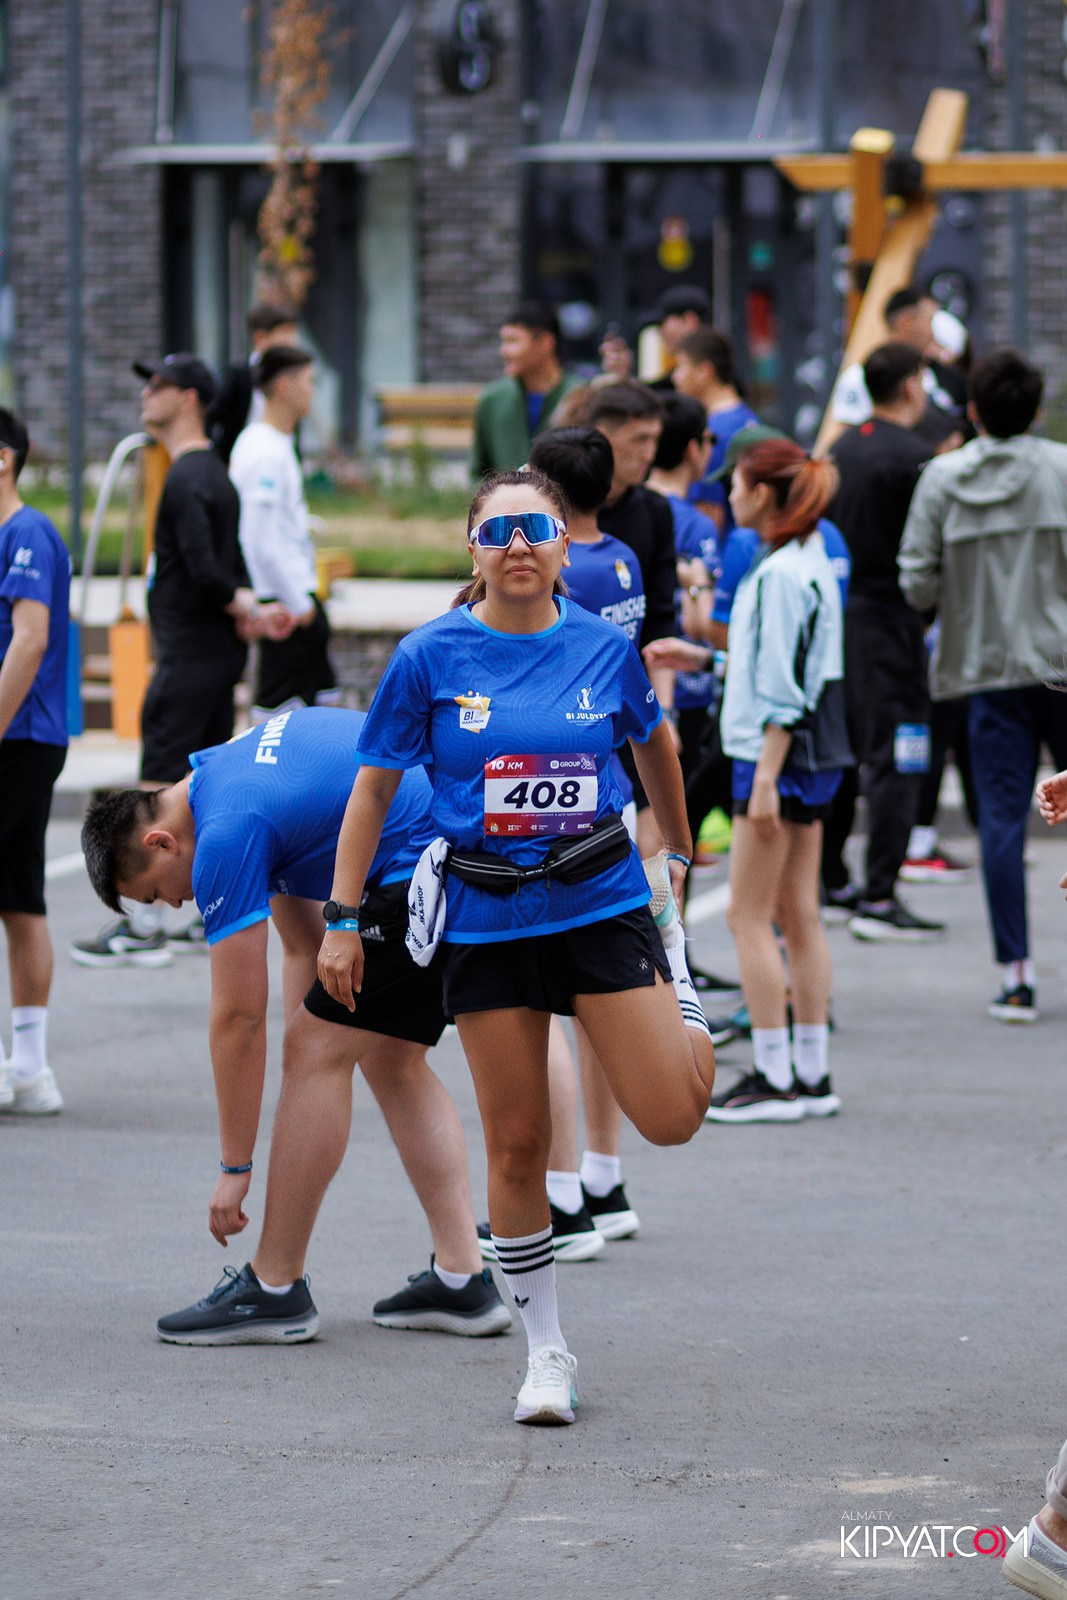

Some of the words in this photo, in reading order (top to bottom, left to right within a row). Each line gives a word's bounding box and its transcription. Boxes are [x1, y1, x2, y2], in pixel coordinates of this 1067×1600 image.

[463, 711, 474, 721] BI
[565, 712, 575, 720] BI
[490, 760, 505, 770] 10
[507, 761, 524, 770] KM
[503, 780, 581, 809] 408
[417, 885, 426, 925] IKA-SHOP
